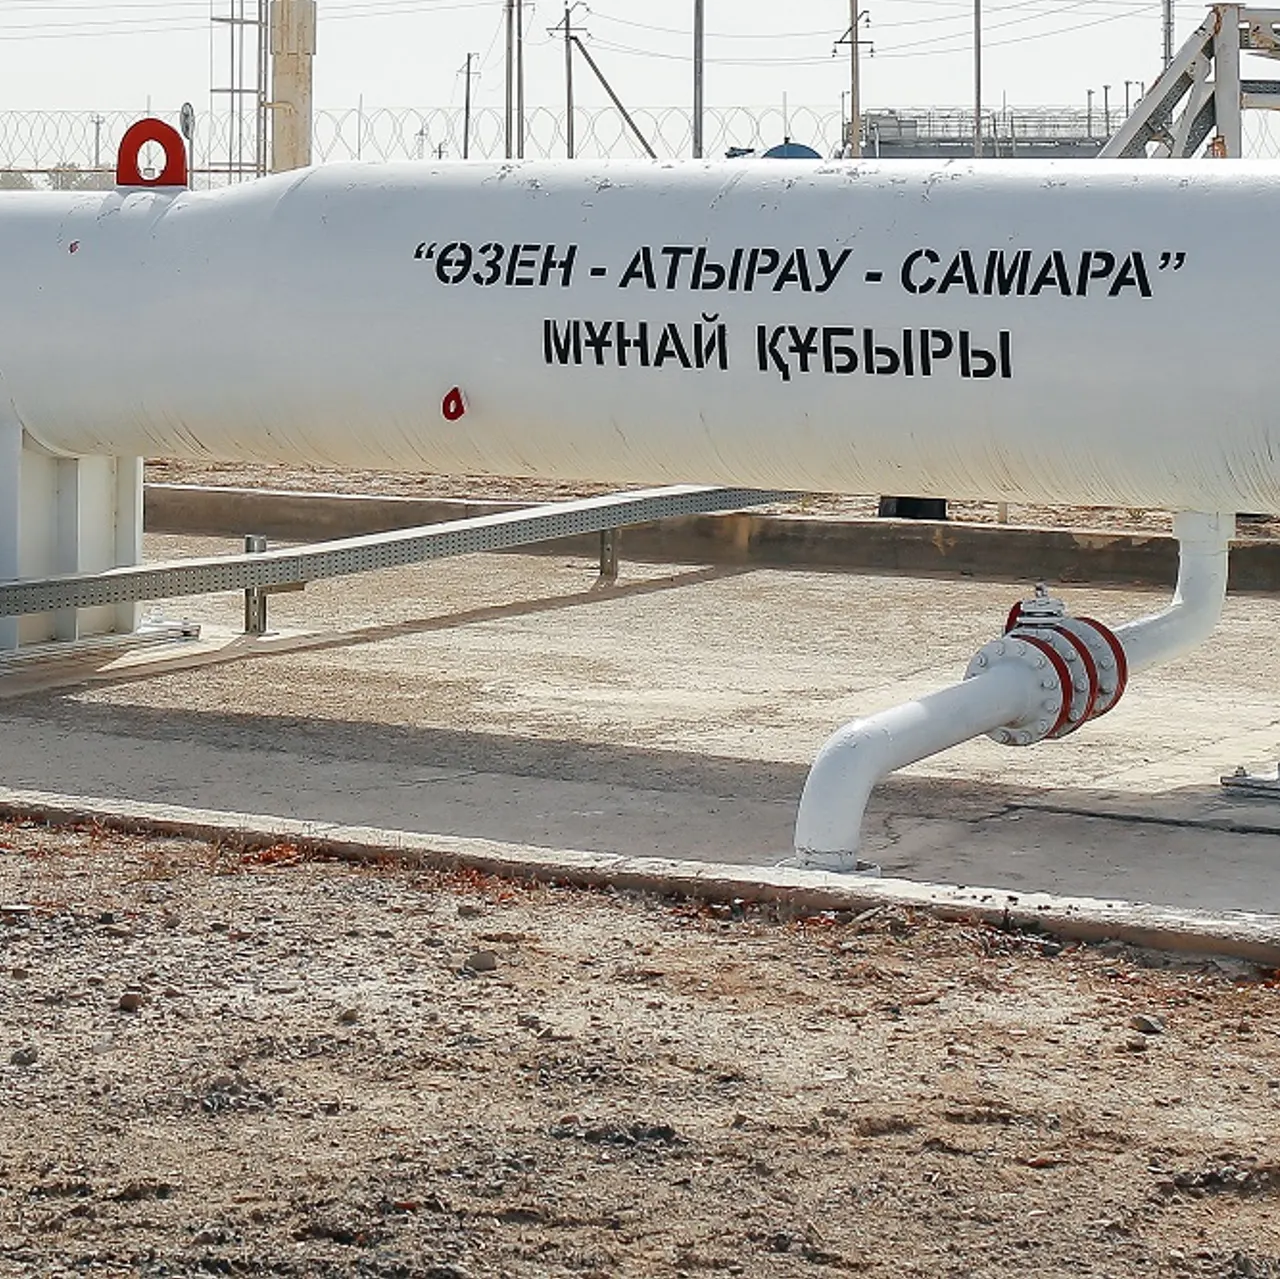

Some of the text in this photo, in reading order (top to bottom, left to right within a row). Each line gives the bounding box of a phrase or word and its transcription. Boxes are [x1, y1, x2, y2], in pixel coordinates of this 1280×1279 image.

[618, 245, 853, 294] АТЫРАУ
[542, 311, 1013, 382] МҰНАЙ ҚҰБЫРЫ
